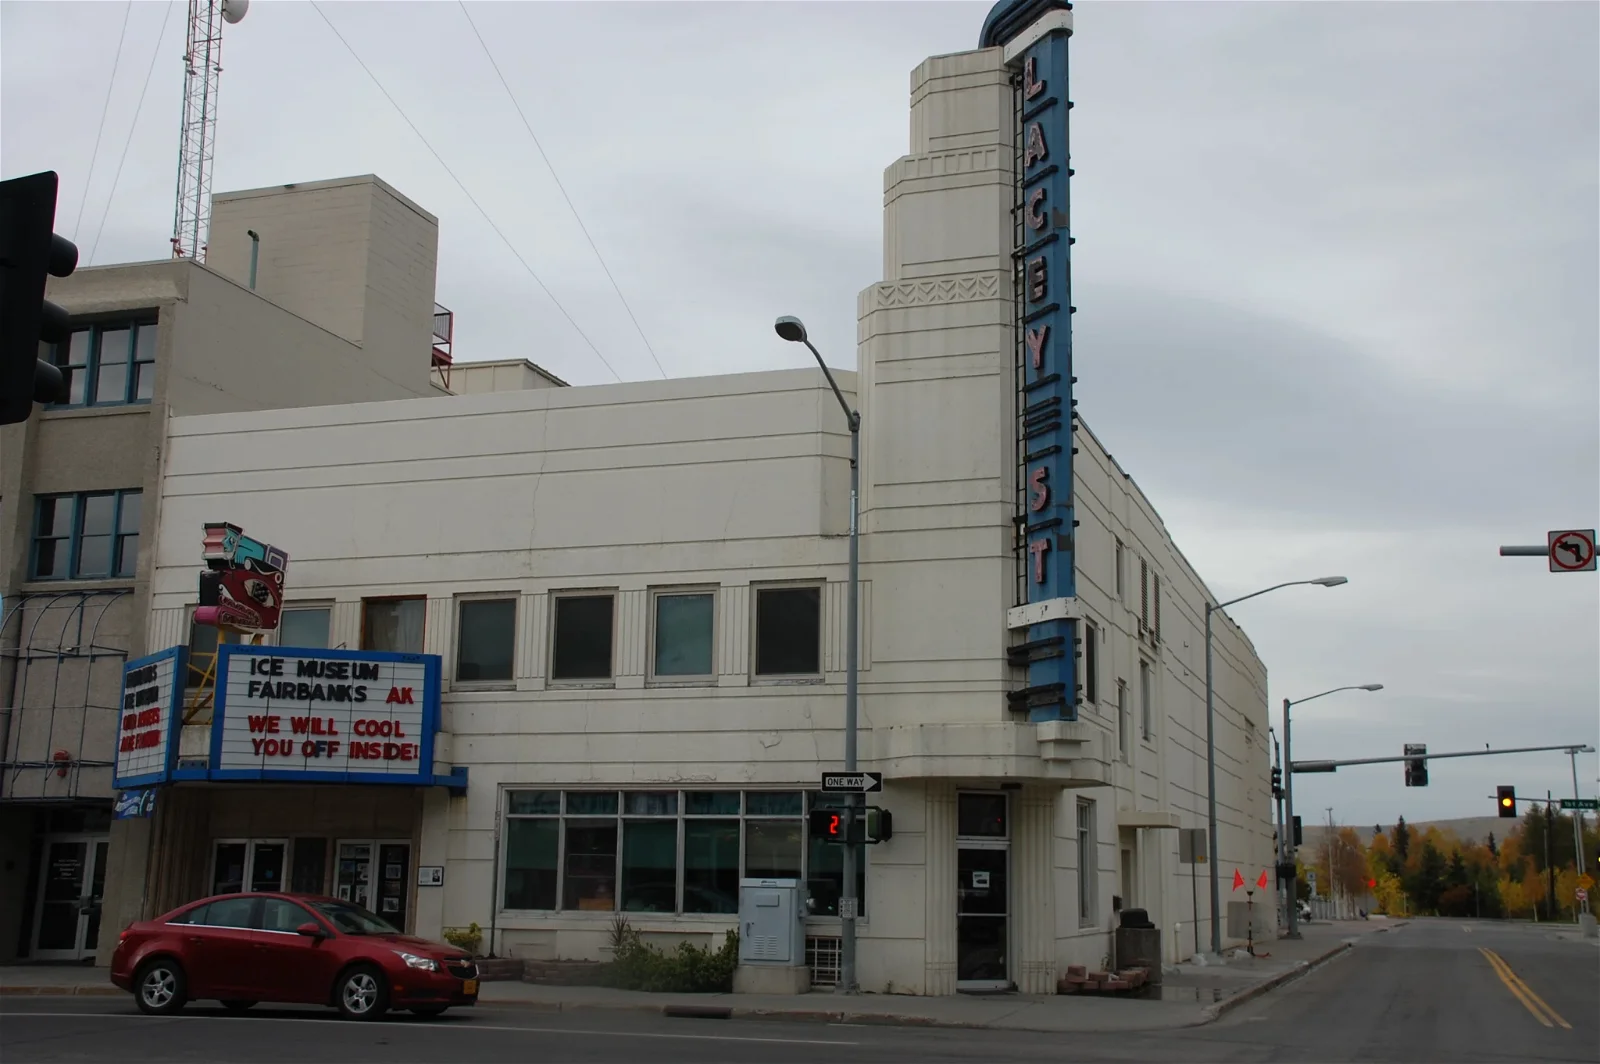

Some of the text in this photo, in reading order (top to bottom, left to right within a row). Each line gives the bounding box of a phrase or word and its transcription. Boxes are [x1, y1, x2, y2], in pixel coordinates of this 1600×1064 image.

[1023, 56, 1052, 585] LACEY ST
[250, 658, 379, 681] ICE MUSEUM
[247, 680, 414, 704] FAIRBANKS AK
[247, 715, 405, 738] WE WILL COOL
[251, 738, 419, 761] YOU OFF INSIDE!
[827, 777, 865, 786] ONE WAY
[829, 815, 839, 834] 2
